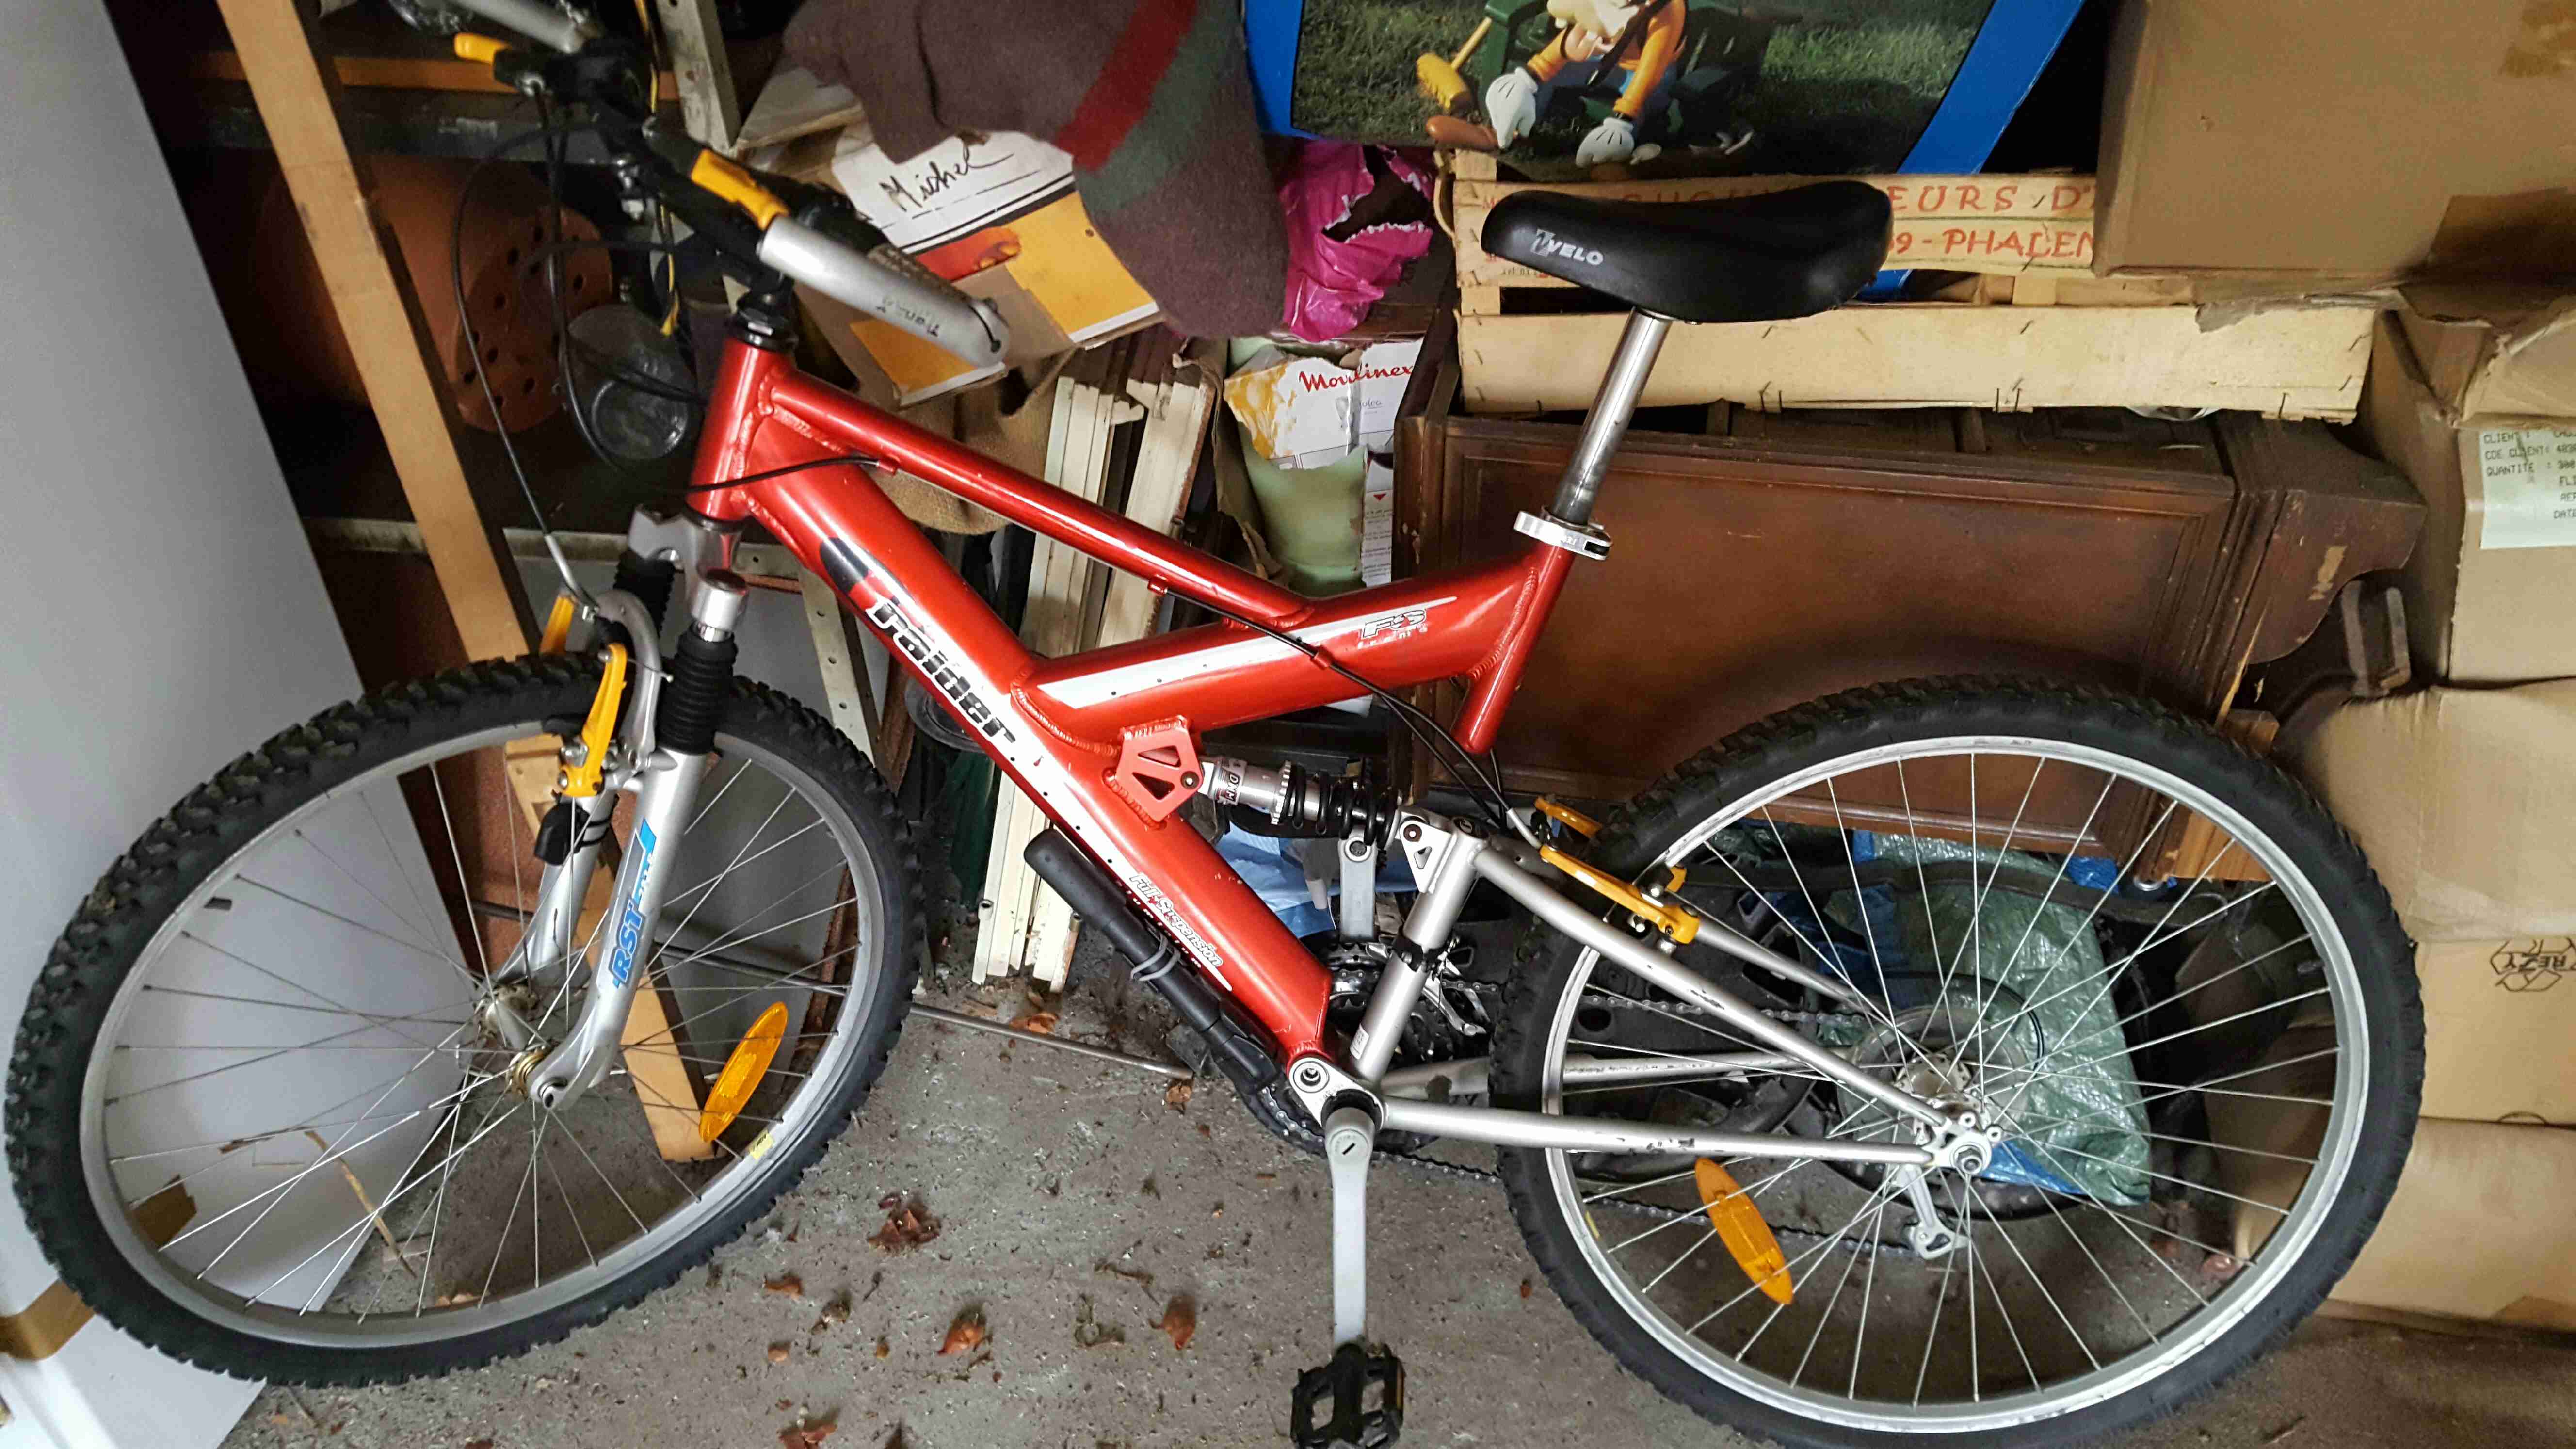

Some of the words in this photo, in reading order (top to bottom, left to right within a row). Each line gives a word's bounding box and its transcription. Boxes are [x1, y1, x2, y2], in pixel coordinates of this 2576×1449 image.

[2052, 185, 2095, 211] D'
[1299, 363, 1413, 392] Moulinex
[873, 602, 1016, 743] raider
[611, 899, 643, 982] RST
